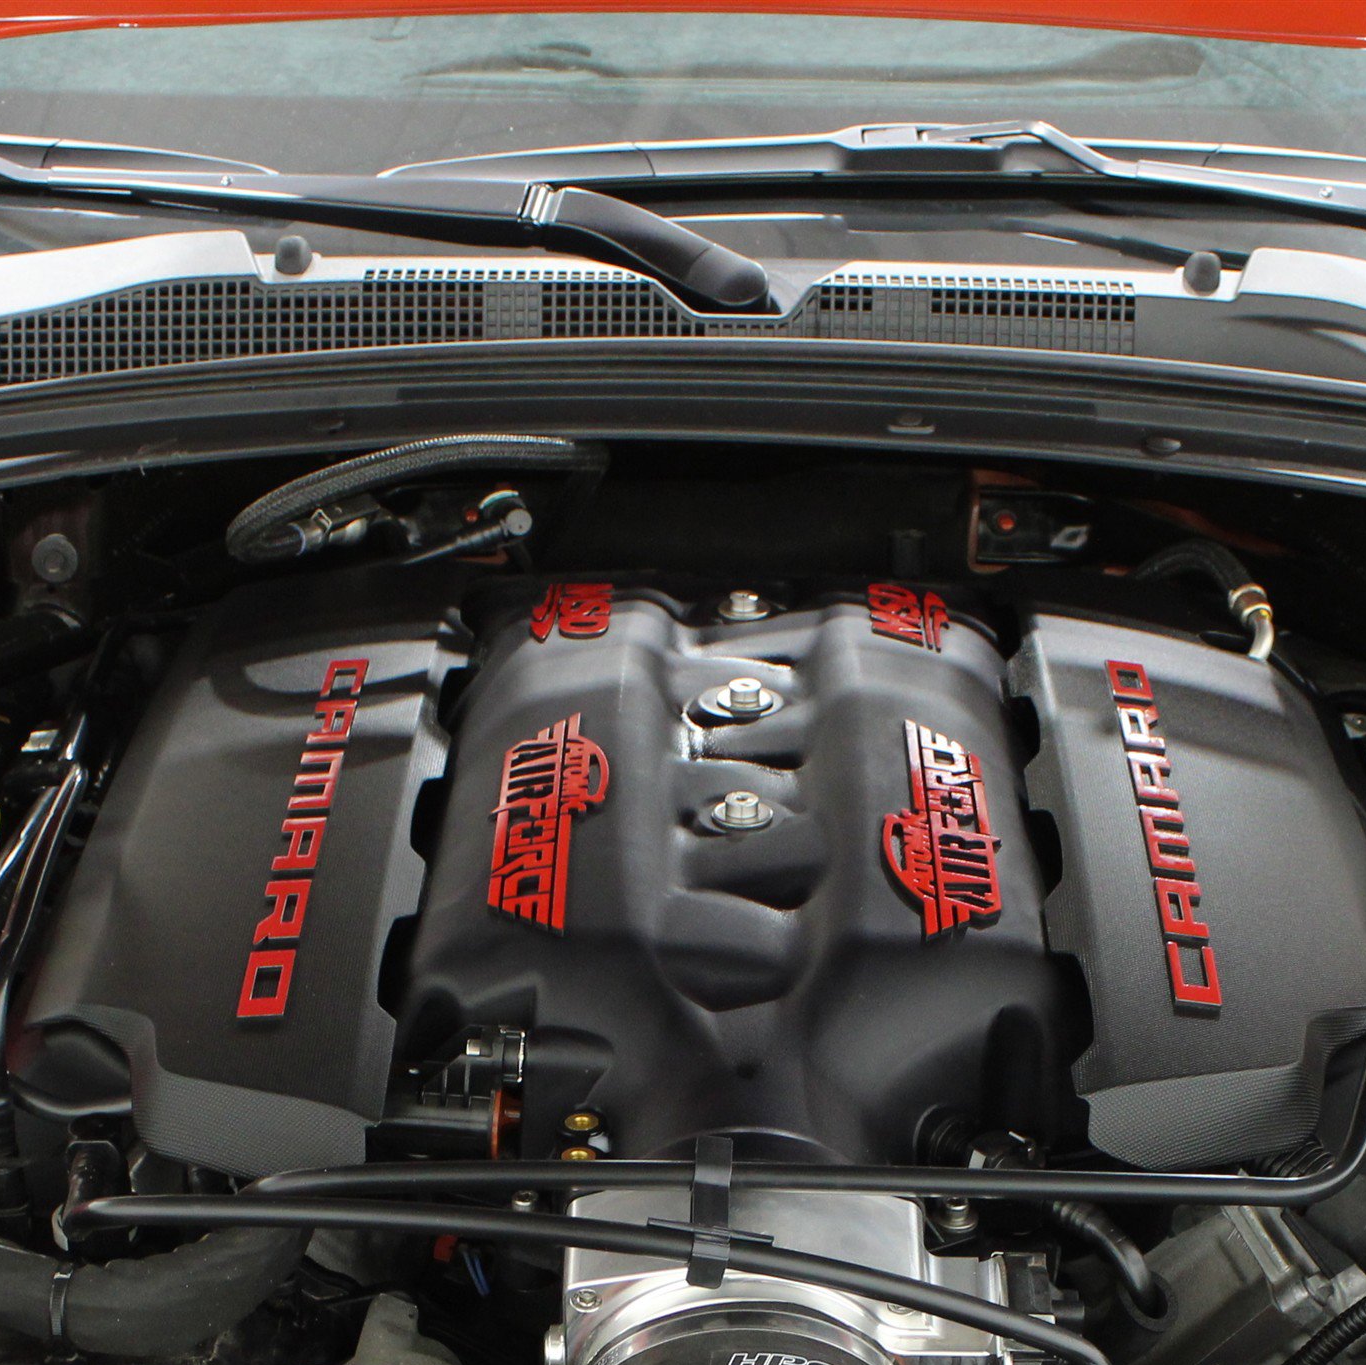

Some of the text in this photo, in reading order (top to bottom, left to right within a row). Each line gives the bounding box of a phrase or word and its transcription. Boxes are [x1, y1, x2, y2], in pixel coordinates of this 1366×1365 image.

[868, 583, 924, 646] MSD
[237, 659, 369, 1017] CAMARO
[1105, 660, 1222, 1010] CAMARO
